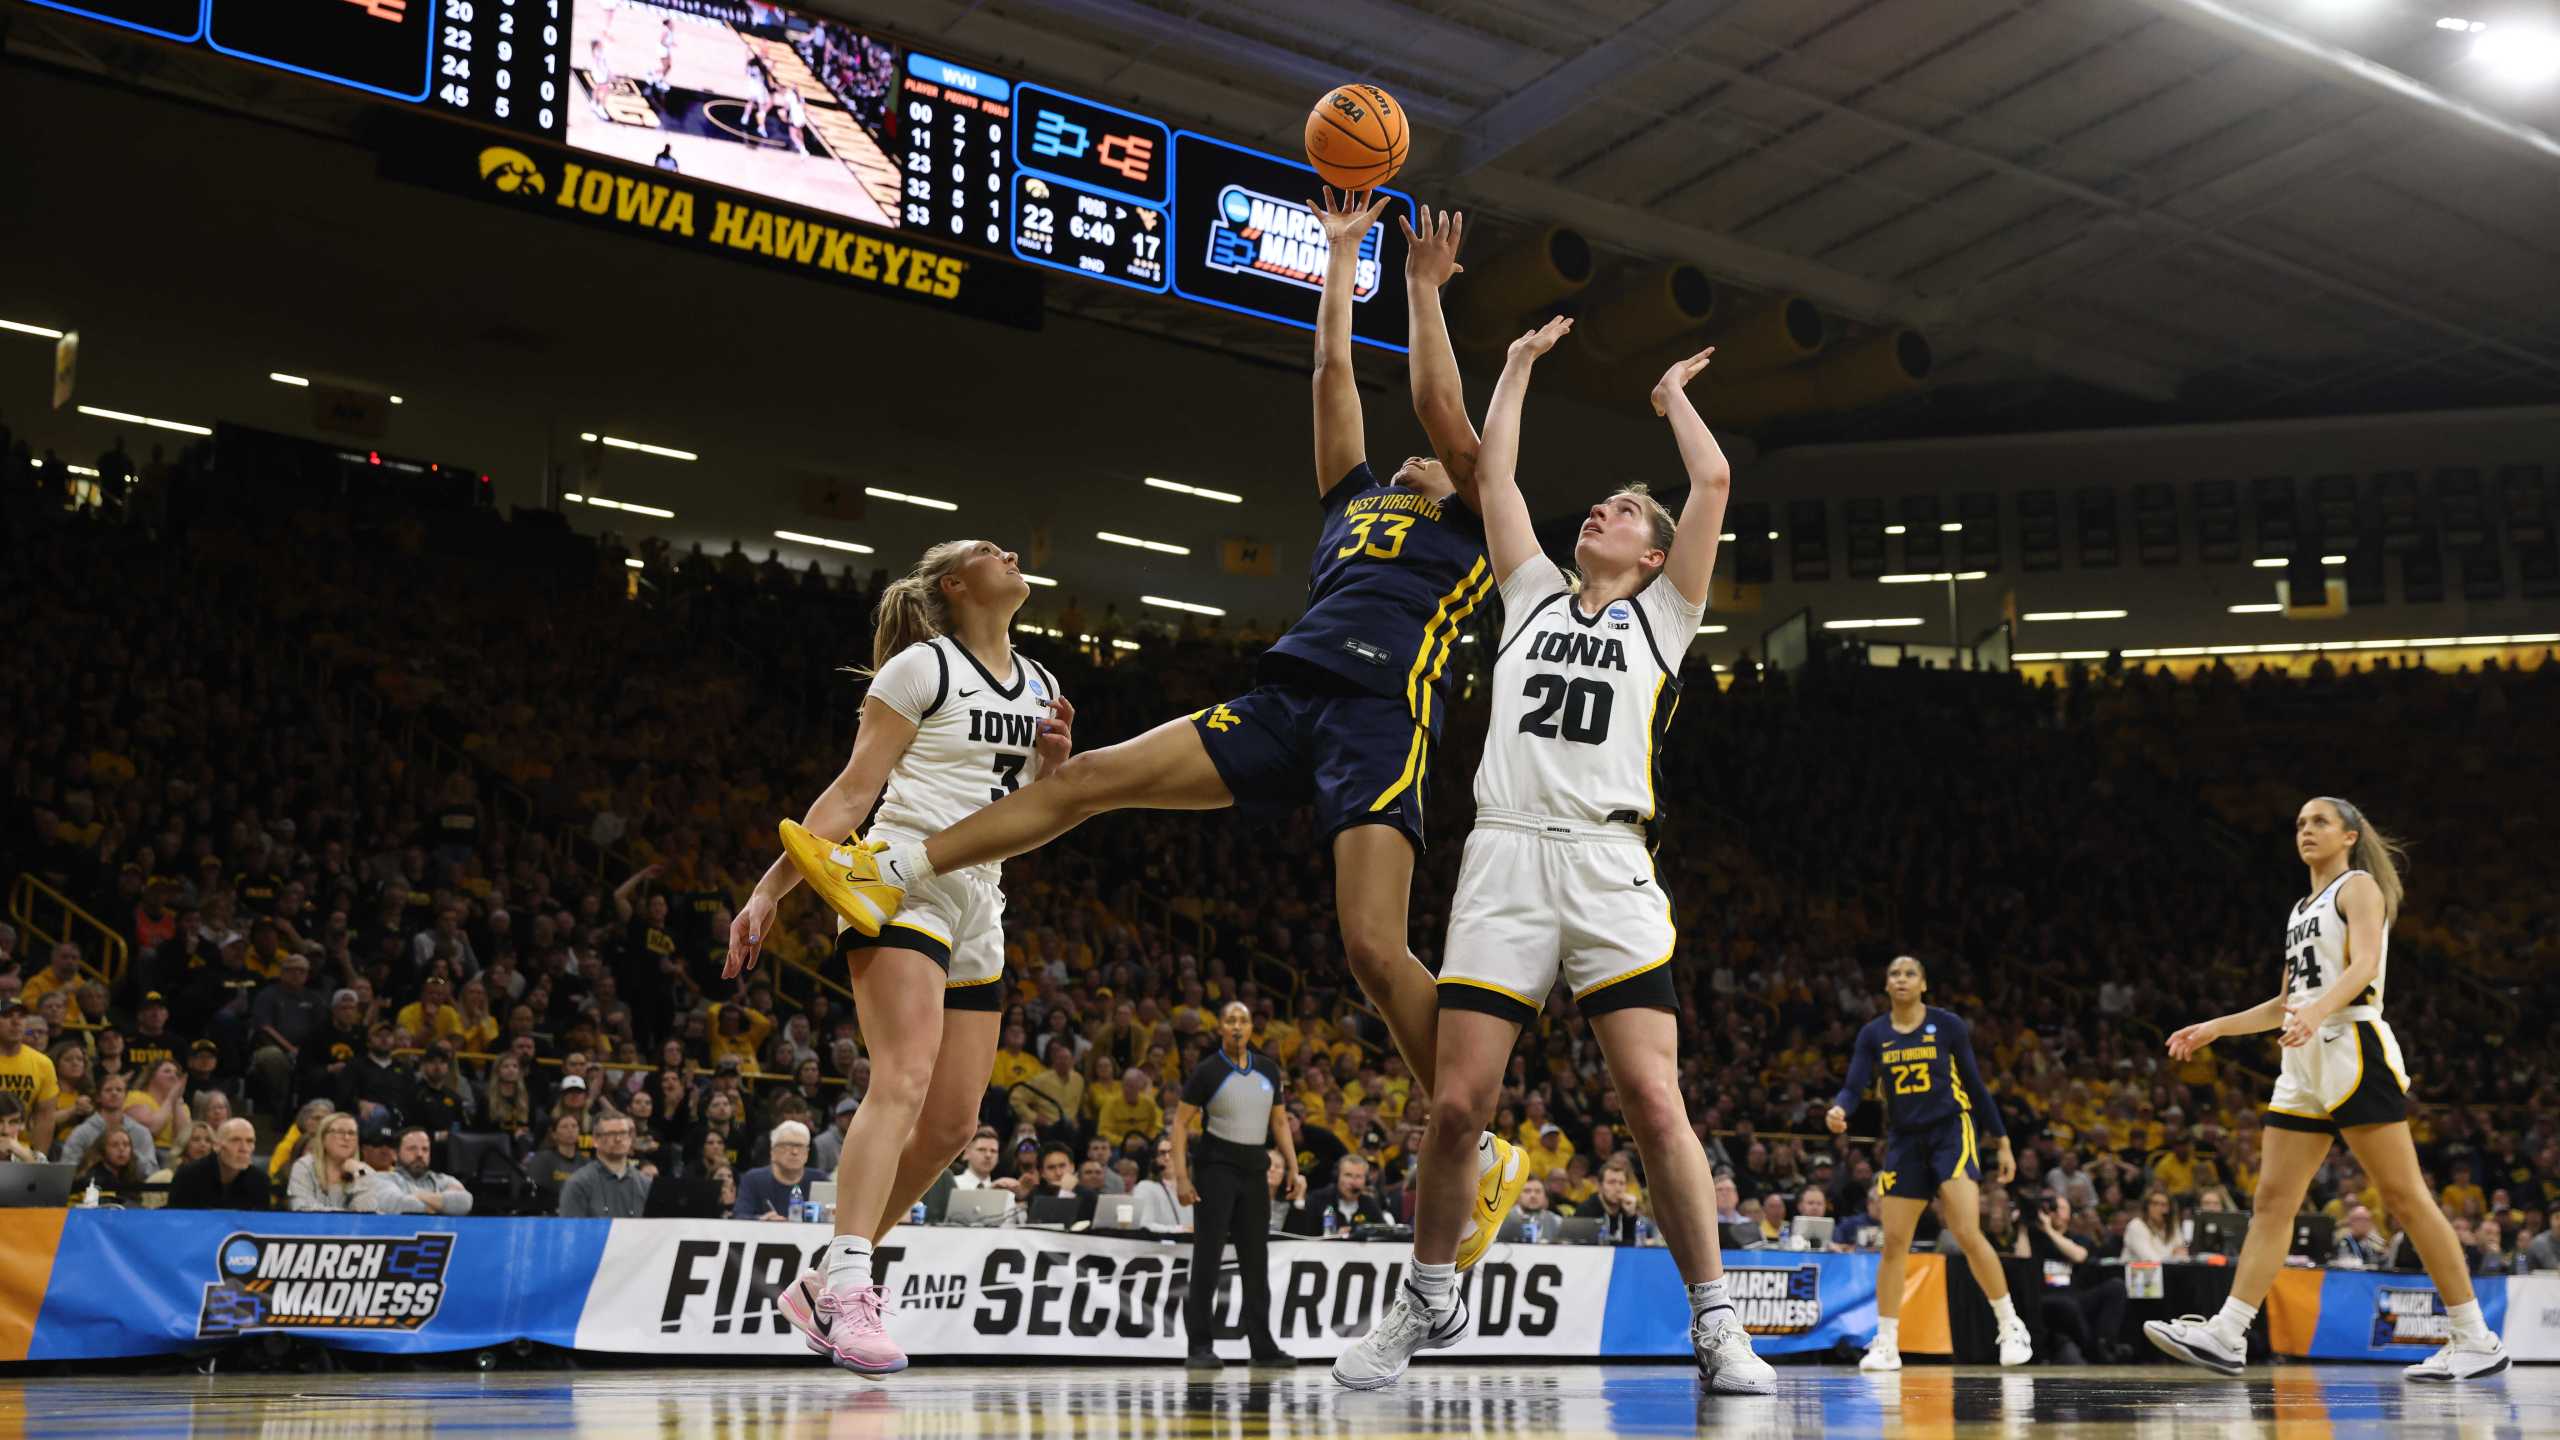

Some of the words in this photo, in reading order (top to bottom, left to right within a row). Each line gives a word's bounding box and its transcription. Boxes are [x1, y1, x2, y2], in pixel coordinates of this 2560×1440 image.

[446, 0, 473, 22] 20
[499, 13, 514, 34] 2
[544, 25, 557, 46] 0
[444, 26, 472, 52] 22
[498, 41, 512, 61] 9
[544, 54, 555, 74] 1
[442, 54, 470, 80] 24
[496, 69, 511, 90] 0
[540, 81, 554, 102] 0
[942, 66, 976, 90] WVU
[440, 83, 469, 107] 45
[495, 97, 510, 117] 5
[539, 108, 553, 129] 0
[909, 101, 932, 124] 00
[953, 114, 966, 133] 2
[989, 124, 1001, 143] 0
[912, 128, 930, 149] 11
[953, 138, 966, 157] 7
[990, 150, 1000, 168] 1
[908, 152, 931, 174] 23
[952, 163, 965, 182] 0
[988, 173, 1000, 192] 0
[907, 177, 930, 200] 32
[952, 189, 964, 208] 5
[989, 200, 999, 218] 1
[557, 164, 696, 237] IOWA
[708, 201, 964, 300] HAWKEYES
[907, 203, 930, 226] 33
[951, 215, 963, 234] 0
[987, 224, 999, 243] 0
[1023, 204, 1054, 234] 22
[1070, 216, 1115, 246] 6:40
[1248, 199, 1329, 248] MARC
[1132, 232, 1160, 260] 17
[1258, 232, 1376, 290] MADNS
[1344, 496, 1380, 518] WEST
[1378, 494, 1442, 522] VIRGINIA
[1338, 513, 1416, 560] 33
[1526, 630, 1627, 672] IOWA
[968, 709, 1038, 748] IOW
[1519, 674, 1614, 745] 20
[990, 752, 1026, 801] 3
[2288, 946, 2322, 994] 24
[1890, 1063, 1931, 1094] 23
[257, 1242, 382, 1280] MARCH
[271, 1281, 440, 1318] MADNESS
[660, 1240, 906, 1334] FIRT
[900, 1274, 966, 1310] AND
